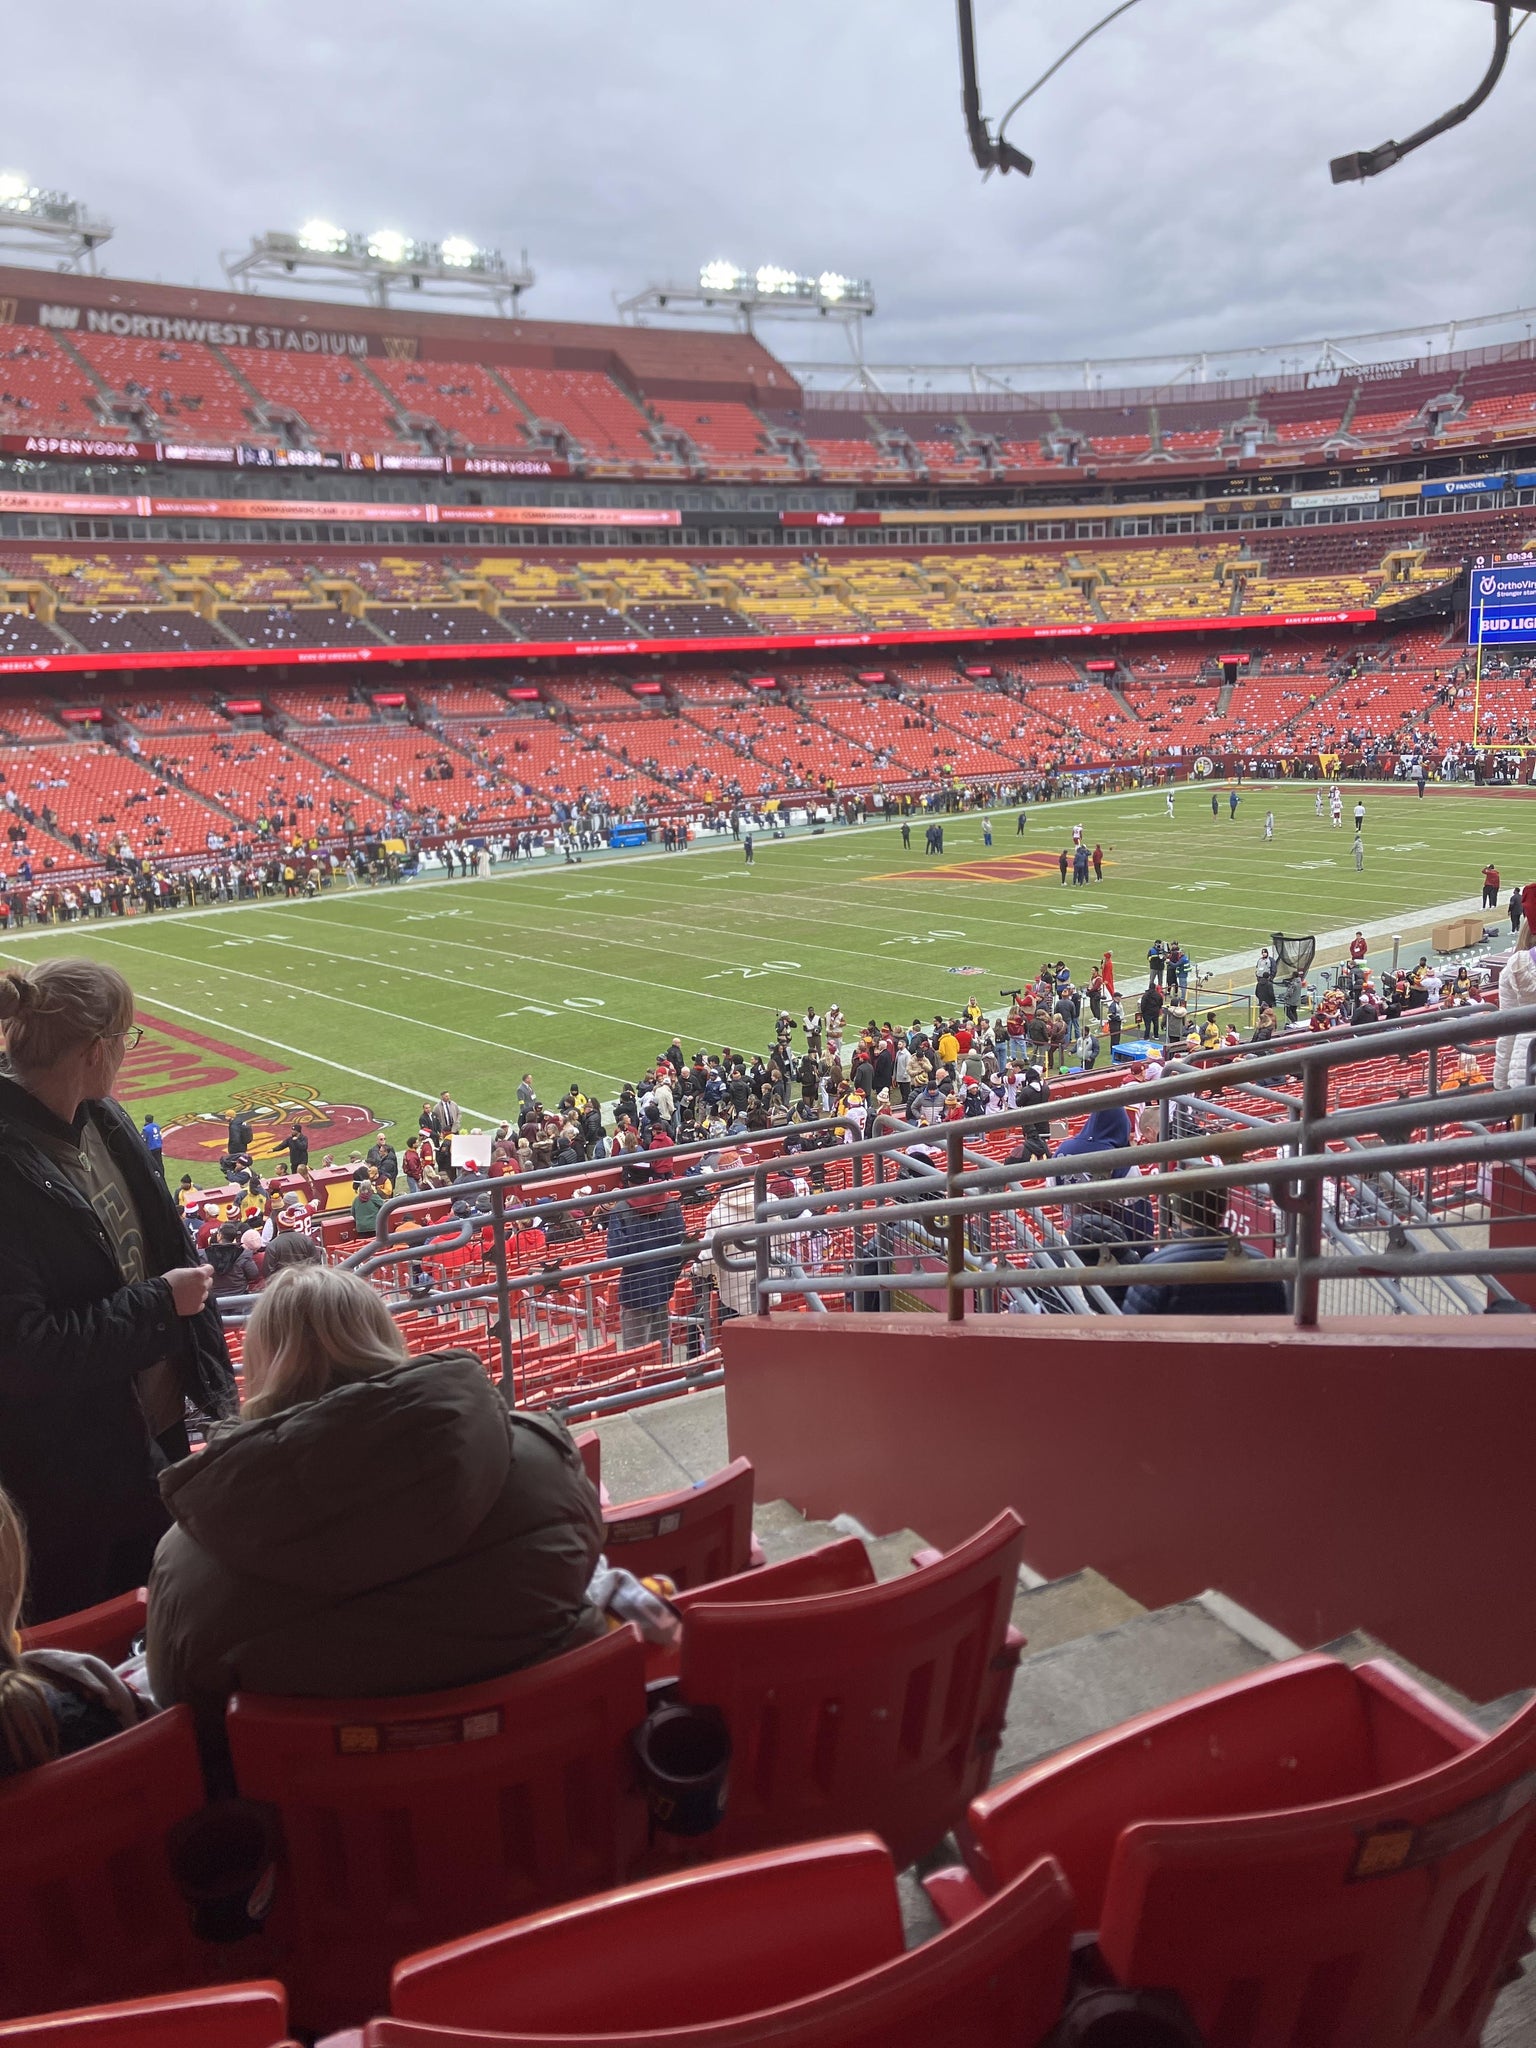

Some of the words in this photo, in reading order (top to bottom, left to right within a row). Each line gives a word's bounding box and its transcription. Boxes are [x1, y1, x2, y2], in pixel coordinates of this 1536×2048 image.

[87, 309, 251, 347] NORTHWEST
[255, 326, 368, 356] STADIUM
[1342, 360, 1418, 378] NORTHWEST
[1357, 372, 1402, 384] STADIUM
[25, 436, 82, 453] ASPEN
[82, 440, 139, 457] VODKA
[465, 458, 508, 473] ASPEN
[508, 460, 552, 475] VODKA
[1481, 618, 1510, 632] BUD
[1511, 617, 1536, 630] LIG
[0, 661, 34, 671] MERICA
[1048, 903, 1109, 916] 40
[892, 929, 966, 944] 30
[720, 960, 802, 979] 20
[518, 997, 605, 1016] 10
[1219, 1209, 1251, 1237] 05
